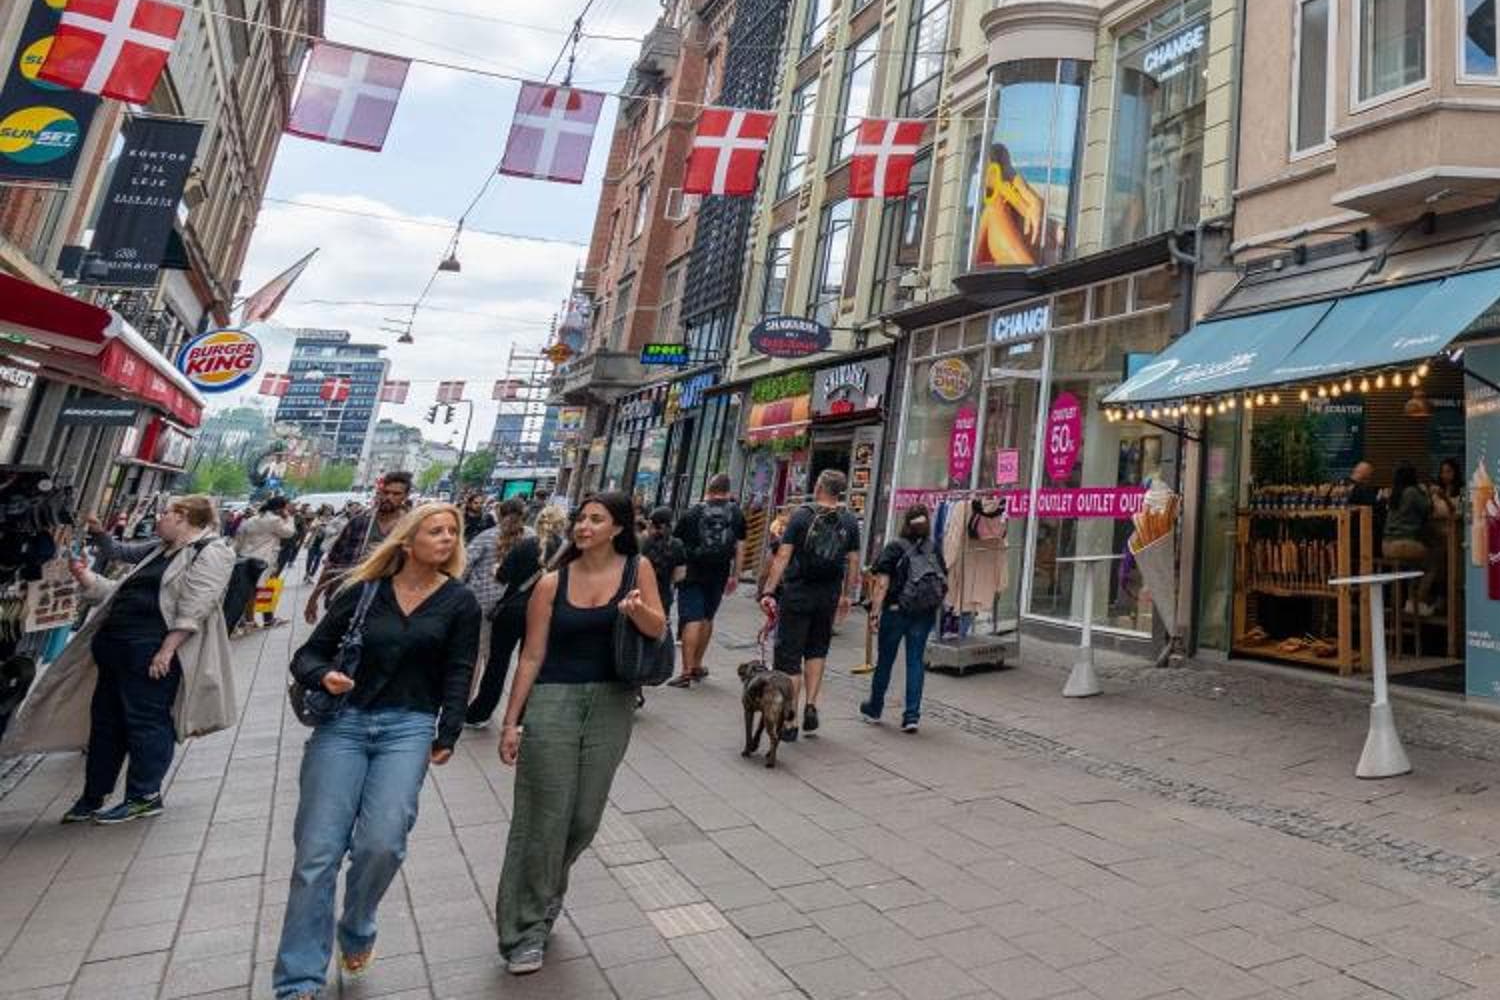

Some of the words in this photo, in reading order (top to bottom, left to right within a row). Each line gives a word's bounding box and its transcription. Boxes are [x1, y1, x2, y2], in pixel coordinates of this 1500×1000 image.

[1143, 25, 1206, 73] CHANGE
[190, 343, 257, 358] BURGER
[186, 353, 254, 376] KING
[1037, 493, 1073, 514] OUTLET
[1077, 492, 1116, 513] OUTLET
[1118, 493, 1147, 513] OUT
